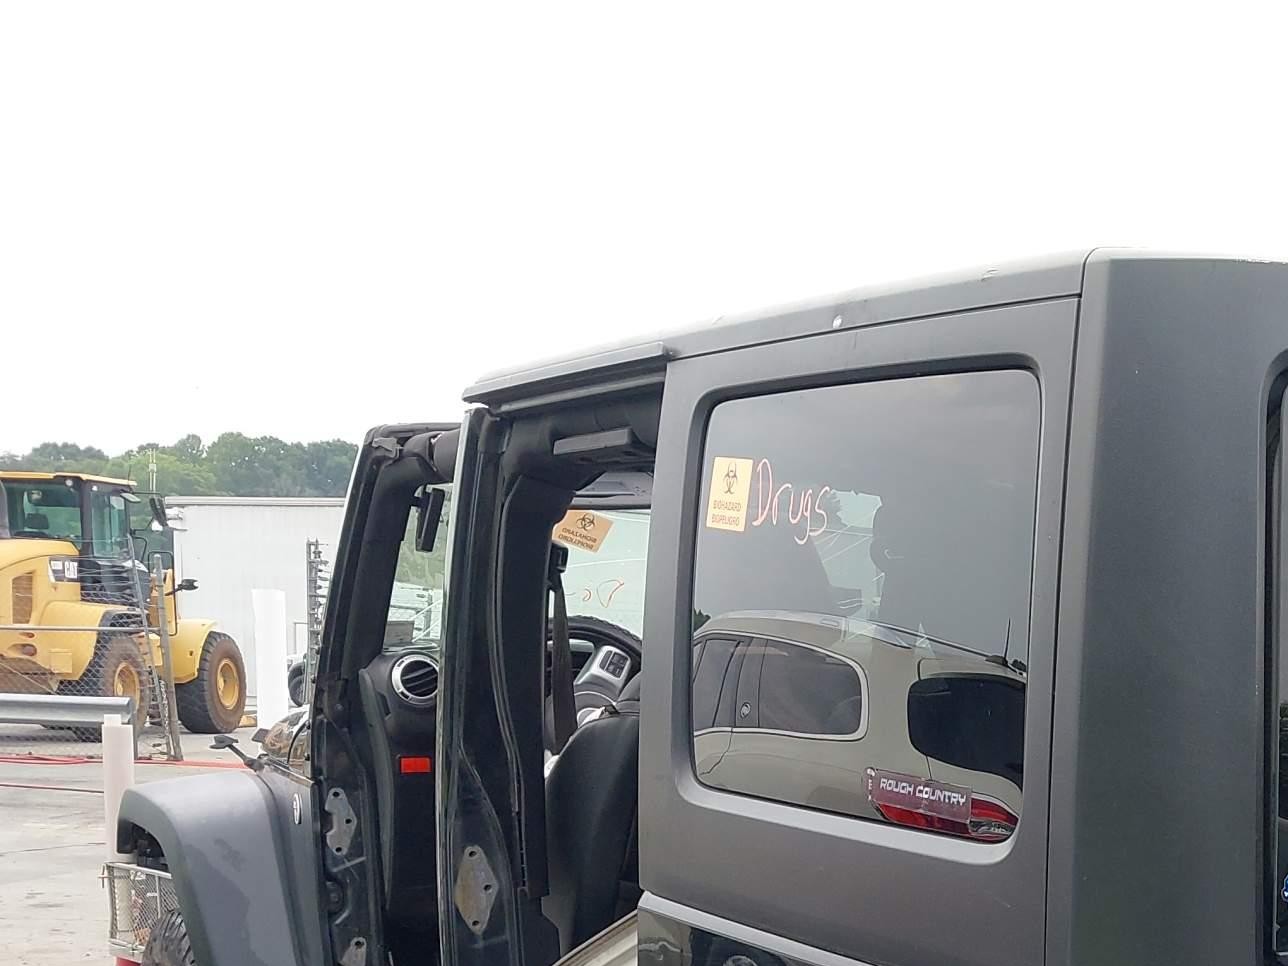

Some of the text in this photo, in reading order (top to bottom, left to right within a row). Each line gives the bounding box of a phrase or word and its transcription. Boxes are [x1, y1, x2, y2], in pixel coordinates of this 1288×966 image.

[751, 458, 830, 545] Drugs
[879, 777, 914, 796] ROUGH
[915, 785, 968, 806] COUNTRY
